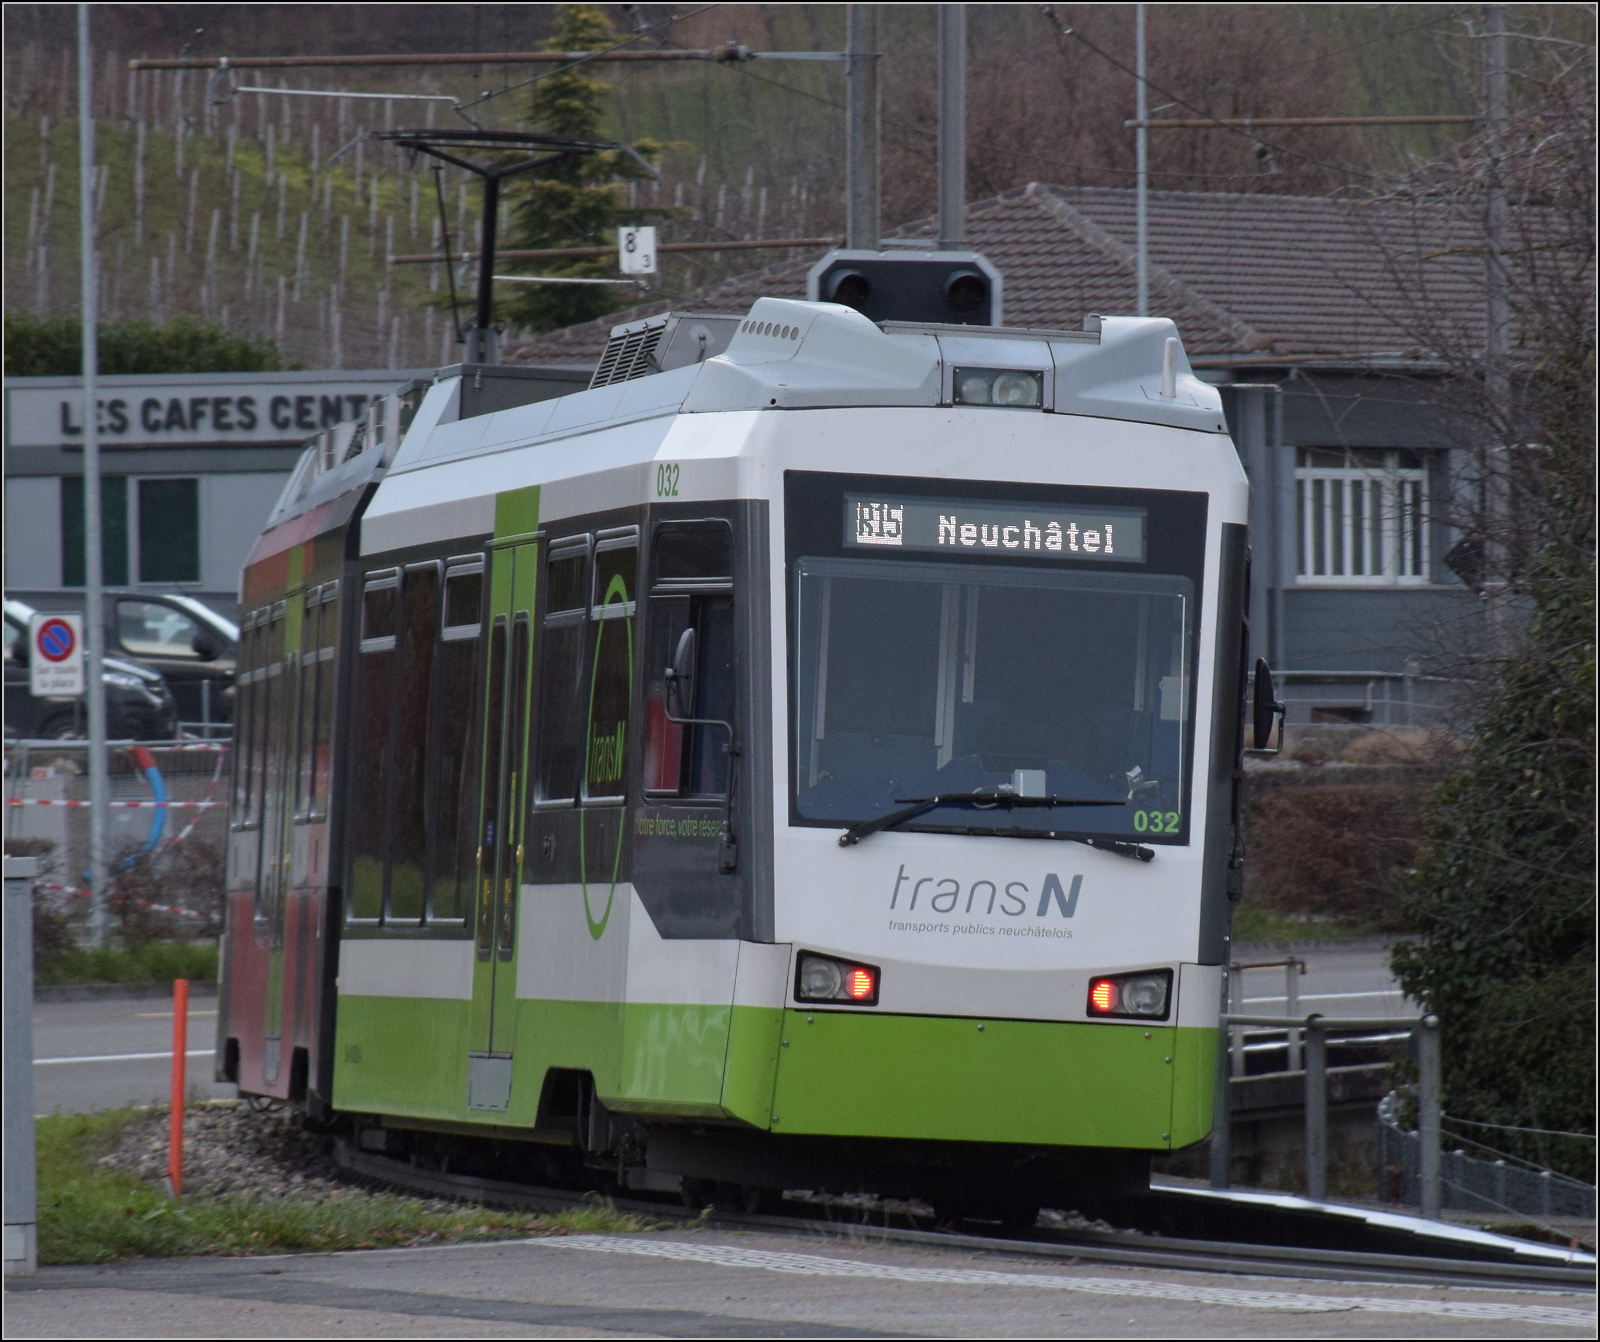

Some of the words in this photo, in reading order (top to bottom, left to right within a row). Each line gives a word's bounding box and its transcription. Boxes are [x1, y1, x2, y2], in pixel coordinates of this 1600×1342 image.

[625, 232, 636, 253] 8
[642, 254, 651, 268] 3
[140, 395, 257, 432] CAFES
[269, 394, 383, 430] CENT
[657, 463, 680, 497] 032
[938, 515, 1114, 553] Neuchâtel
[589, 720, 625, 783] transN
[635, 816, 654, 835] notre
[656, 813, 677, 839] force,
[679, 816, 697, 837] votre
[1133, 810, 1179, 833] 032
[888, 920, 950, 933] transports
[953, 924, 995, 936] publics
[998, 925, 1073, 939] neuchâtelois
